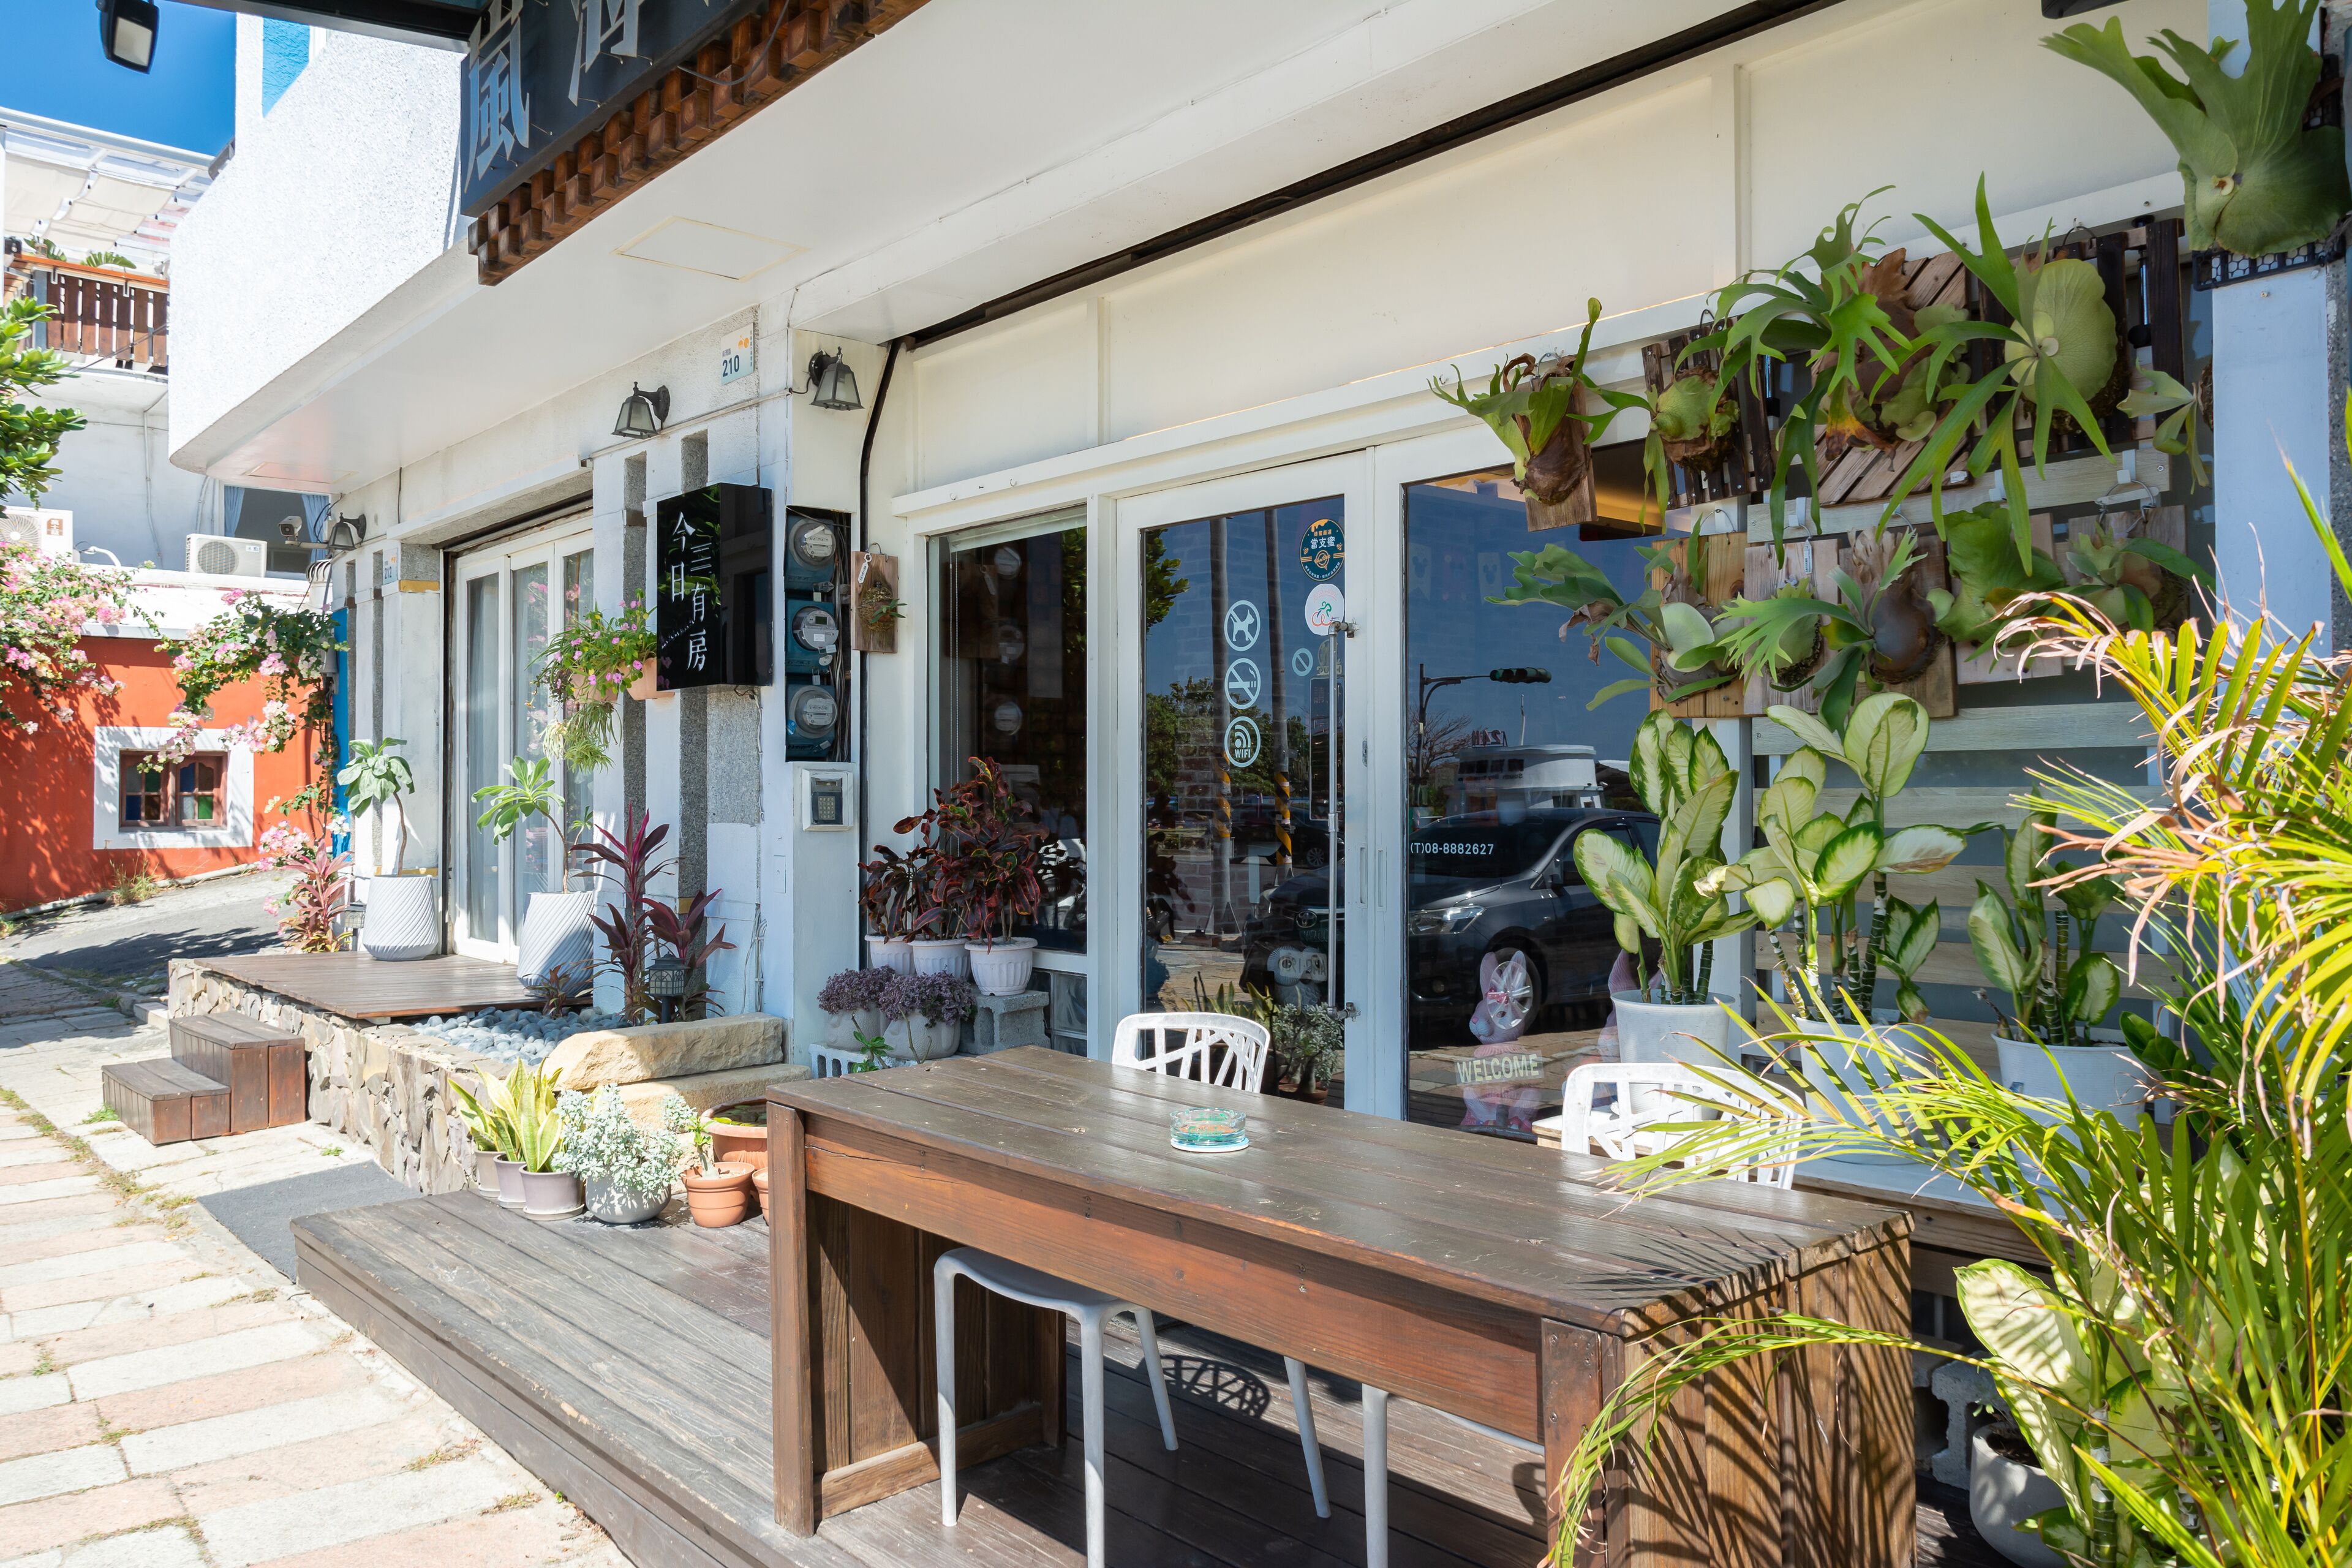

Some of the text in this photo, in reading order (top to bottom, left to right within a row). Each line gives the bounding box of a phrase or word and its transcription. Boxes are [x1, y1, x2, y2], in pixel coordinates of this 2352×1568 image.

[722, 355, 739, 377] 210
[1311, 536, 1335, 549] 當支蜜
[671, 511, 696, 603] 今日
[1235, 749, 1251, 758] WIFI
[1410, 842, 1494, 855] (T)08-8882627
[1457, 1054, 1539, 1083] WELCOME
